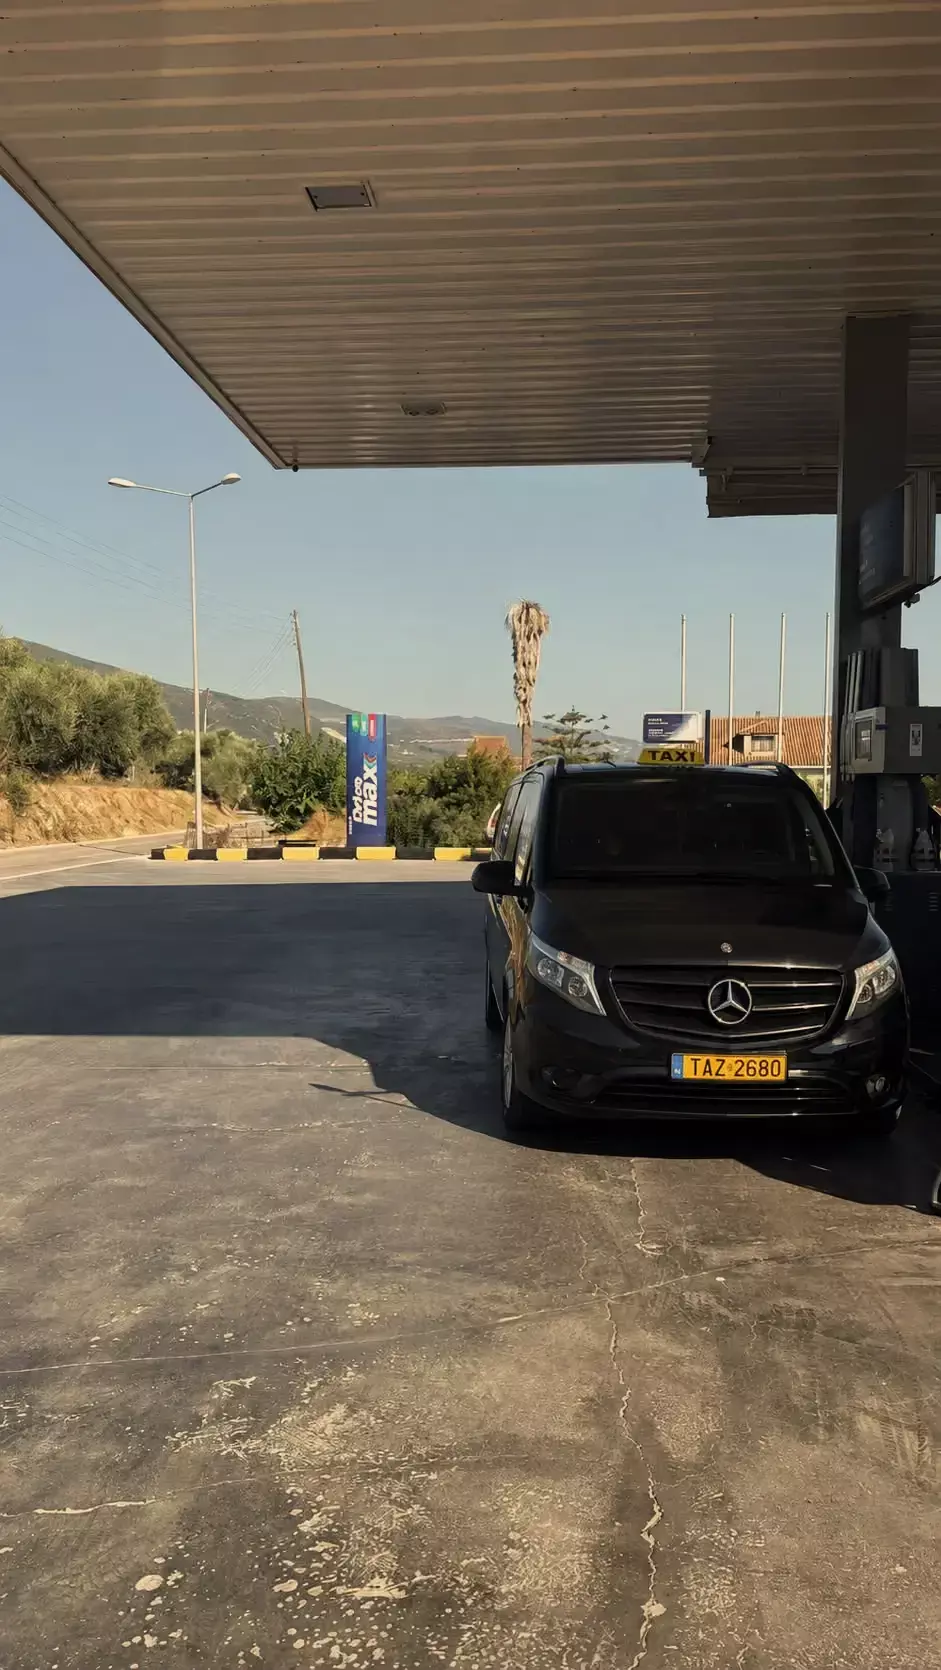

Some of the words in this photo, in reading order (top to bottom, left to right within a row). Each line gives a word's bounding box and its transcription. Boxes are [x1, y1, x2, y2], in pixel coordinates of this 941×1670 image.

[648, 750, 696, 762] TAXI
[363, 759, 378, 827] max
[690, 1057, 726, 1077] TAZ
[734, 1059, 781, 1077] 2680
